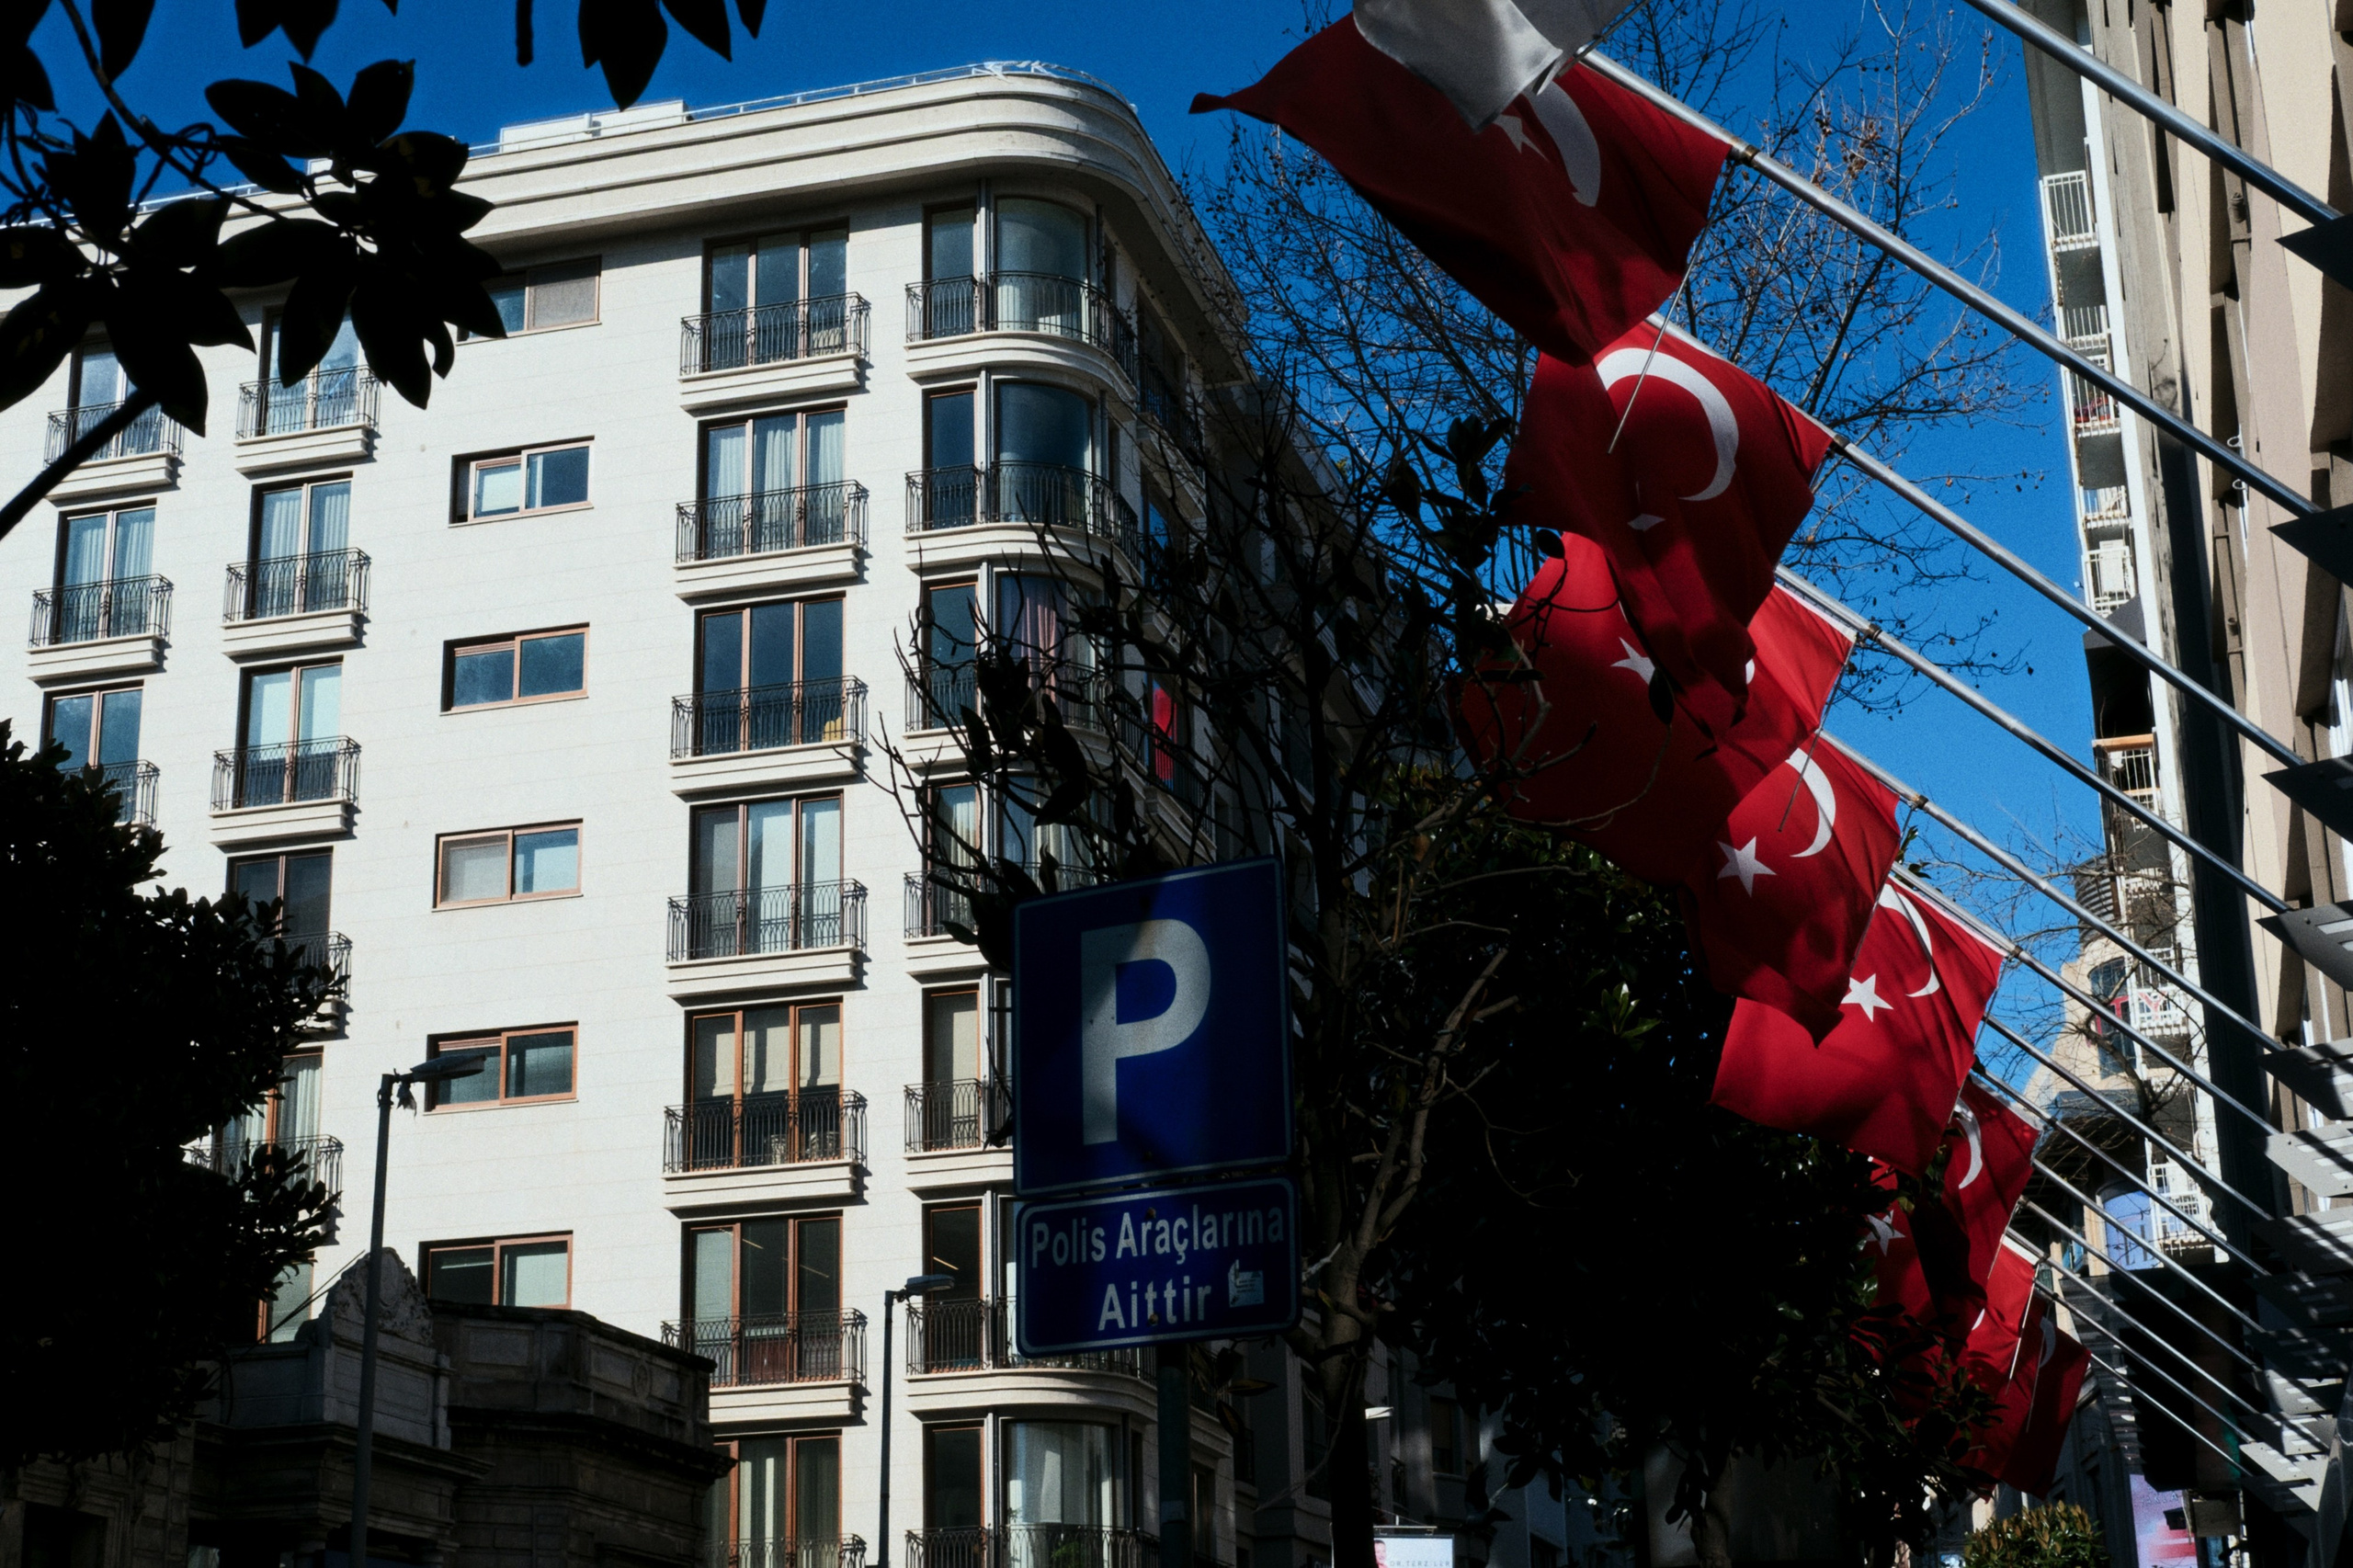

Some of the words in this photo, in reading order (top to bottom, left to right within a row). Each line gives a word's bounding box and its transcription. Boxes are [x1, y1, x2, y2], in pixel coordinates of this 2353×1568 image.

[1080, 918, 1211, 1145] P
[1031, 1215, 1106, 1268] Polis
[1116, 1204, 1284, 1265] Araçlarına
[1097, 1274, 1211, 1332] Aittir
